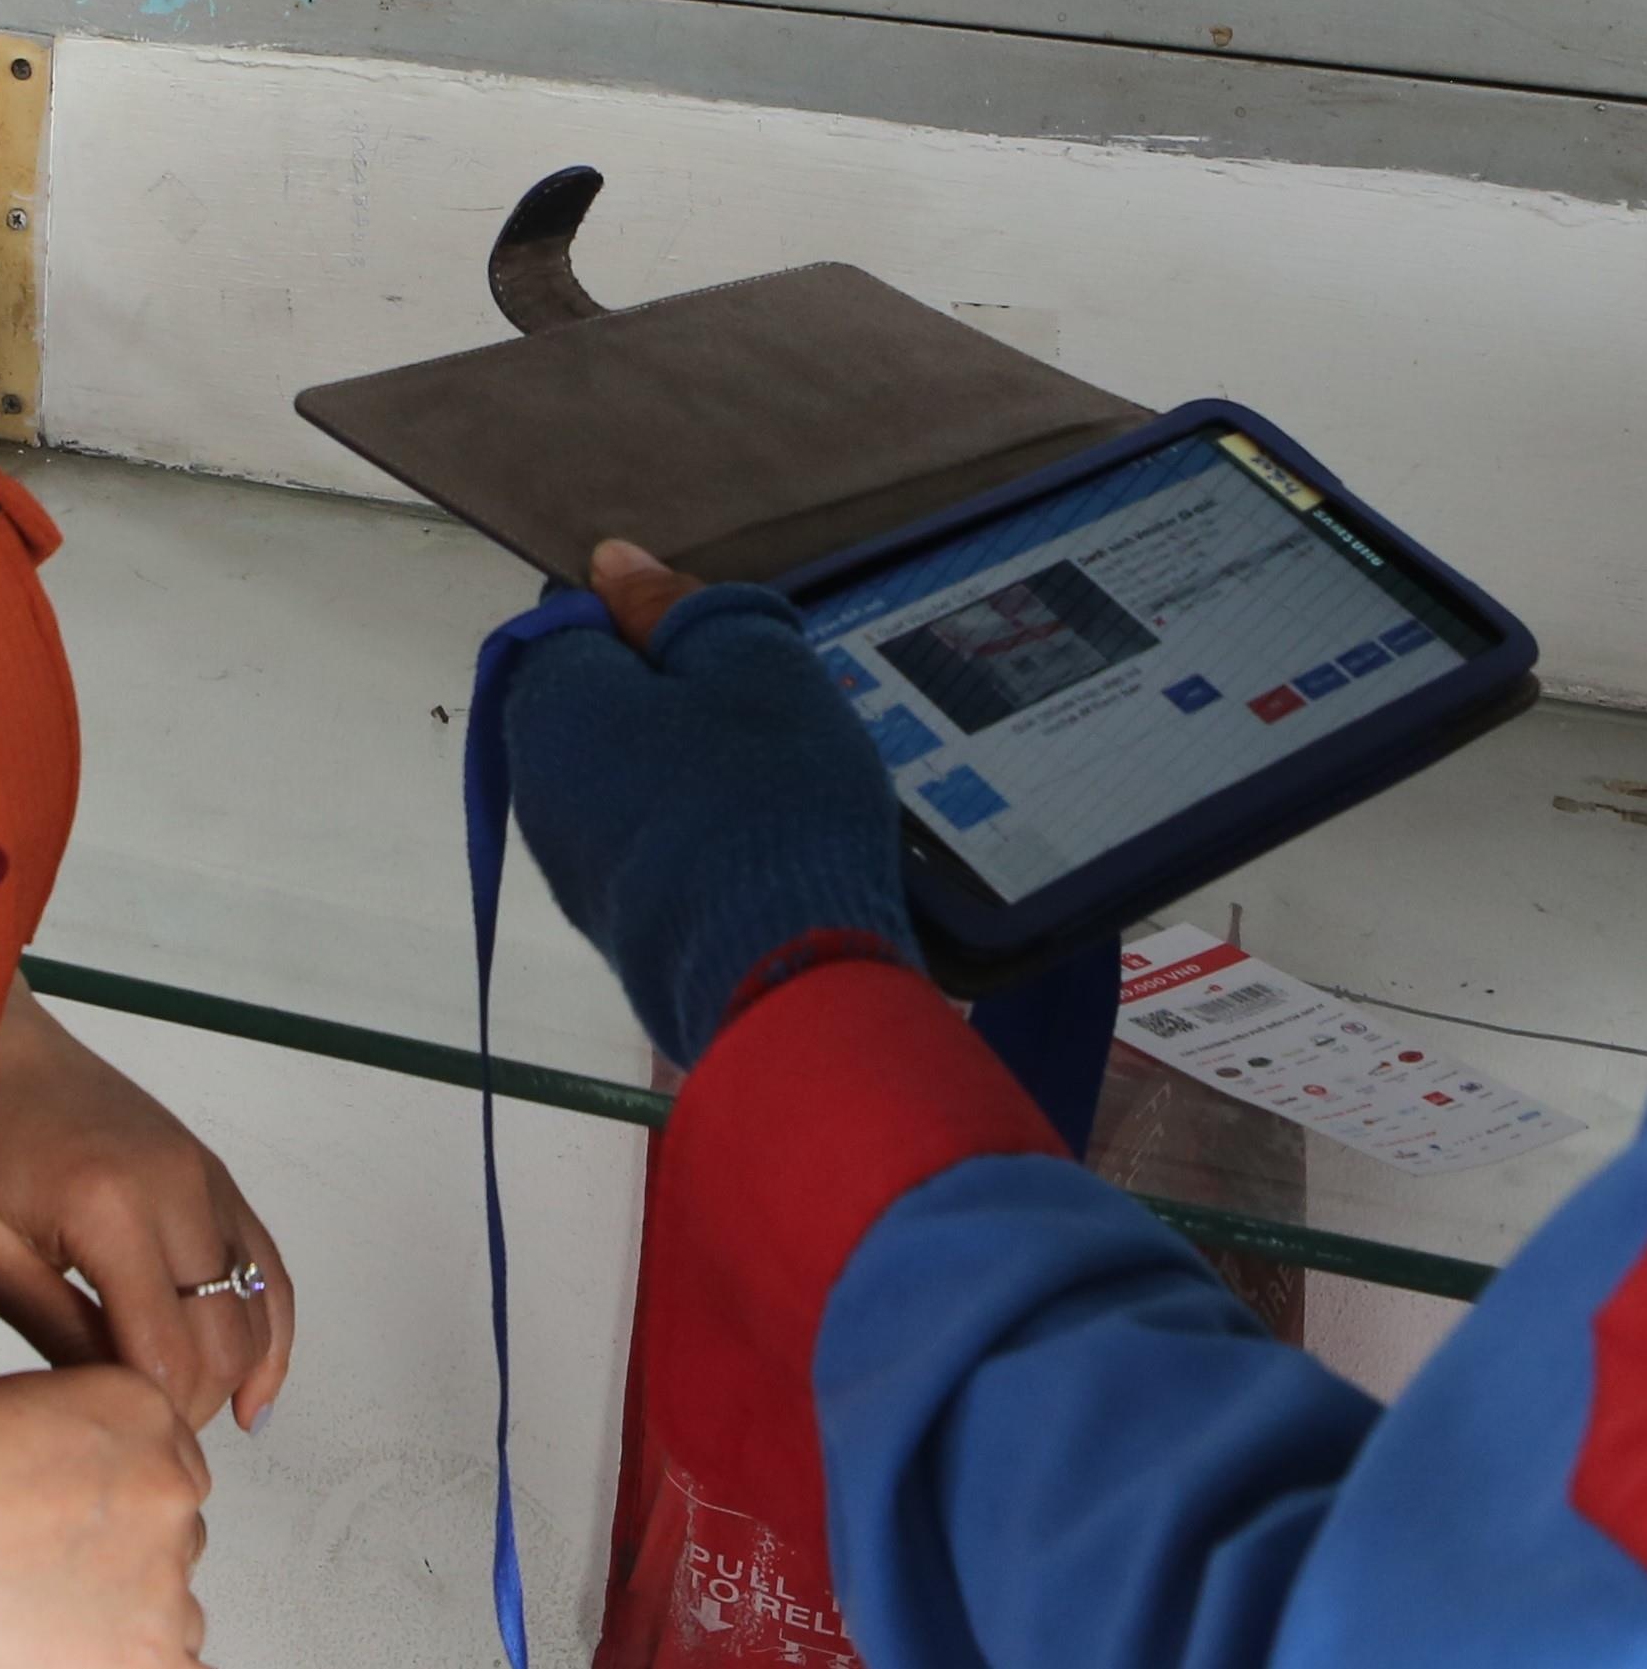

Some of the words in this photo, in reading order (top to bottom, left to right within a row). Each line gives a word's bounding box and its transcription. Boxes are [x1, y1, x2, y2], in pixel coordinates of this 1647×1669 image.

[1165, 963, 1202, 981] VNĐ
[686, 1564, 740, 1604] TO
[689, 1542, 796, 1601] PULL
